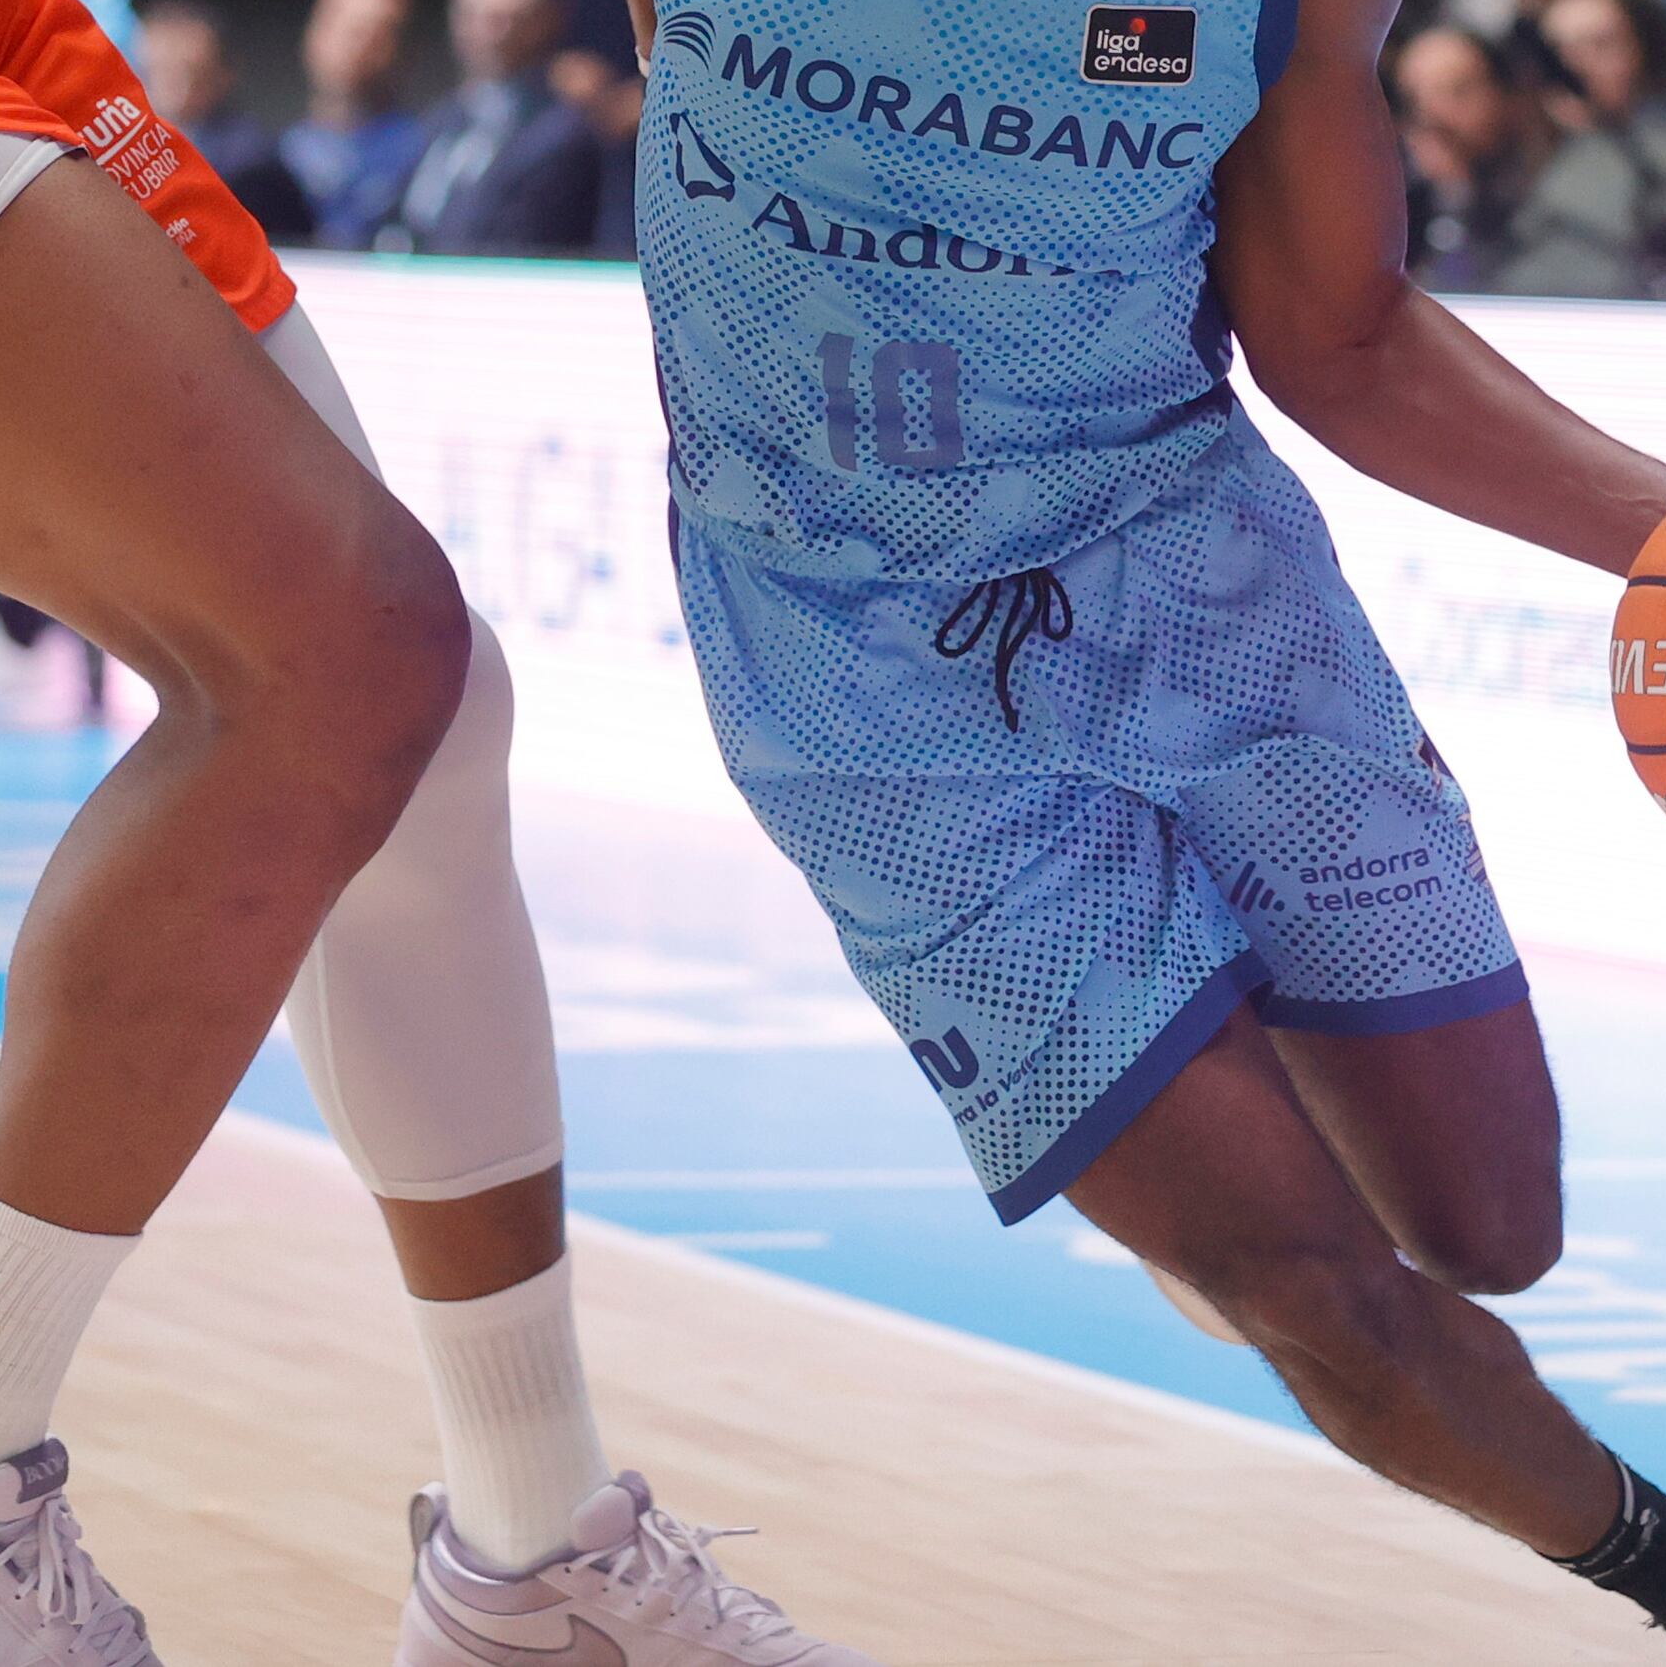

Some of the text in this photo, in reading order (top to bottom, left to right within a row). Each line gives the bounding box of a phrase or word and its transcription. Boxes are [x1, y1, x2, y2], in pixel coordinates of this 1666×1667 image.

[1094, 52, 1187, 74] endesa
[1096, 29, 1140, 54] liga
[77, 96, 141, 147] uña
[721, 34, 1204, 170] MORABANC
[123, 148, 180, 199] UBRIR
[815, 331, 965, 472] 10
[1299, 847, 1430, 884] andorra
[1304, 875, 1442, 912] telecom
